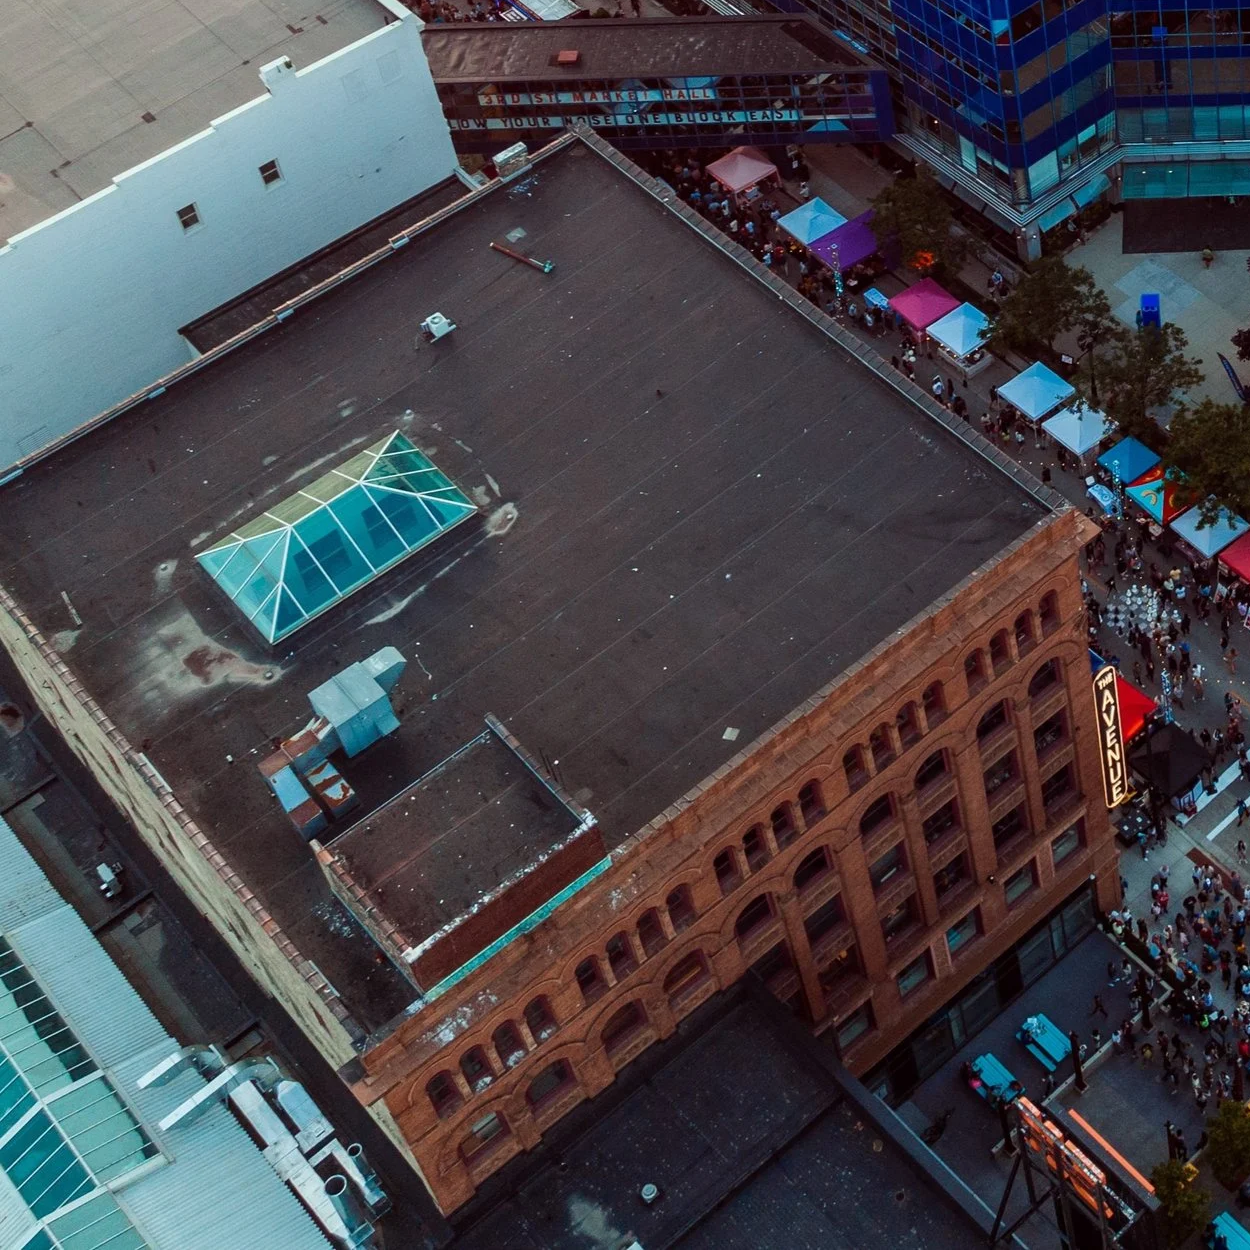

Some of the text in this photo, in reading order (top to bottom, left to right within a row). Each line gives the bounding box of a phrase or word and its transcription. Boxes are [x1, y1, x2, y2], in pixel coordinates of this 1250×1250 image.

[485, 94, 521, 106] 3RD
[572, 89, 649, 102] MARKET
[663, 87, 711, 100] HALL
[502, 116, 551, 128] YOUR
[625, 113, 660, 125] ONE
[675, 111, 737, 123] BLOCK
[750, 109, 795, 121] EAST
[1097, 672, 1114, 690] THE
[1102, 689, 1124, 802] AVENUE
